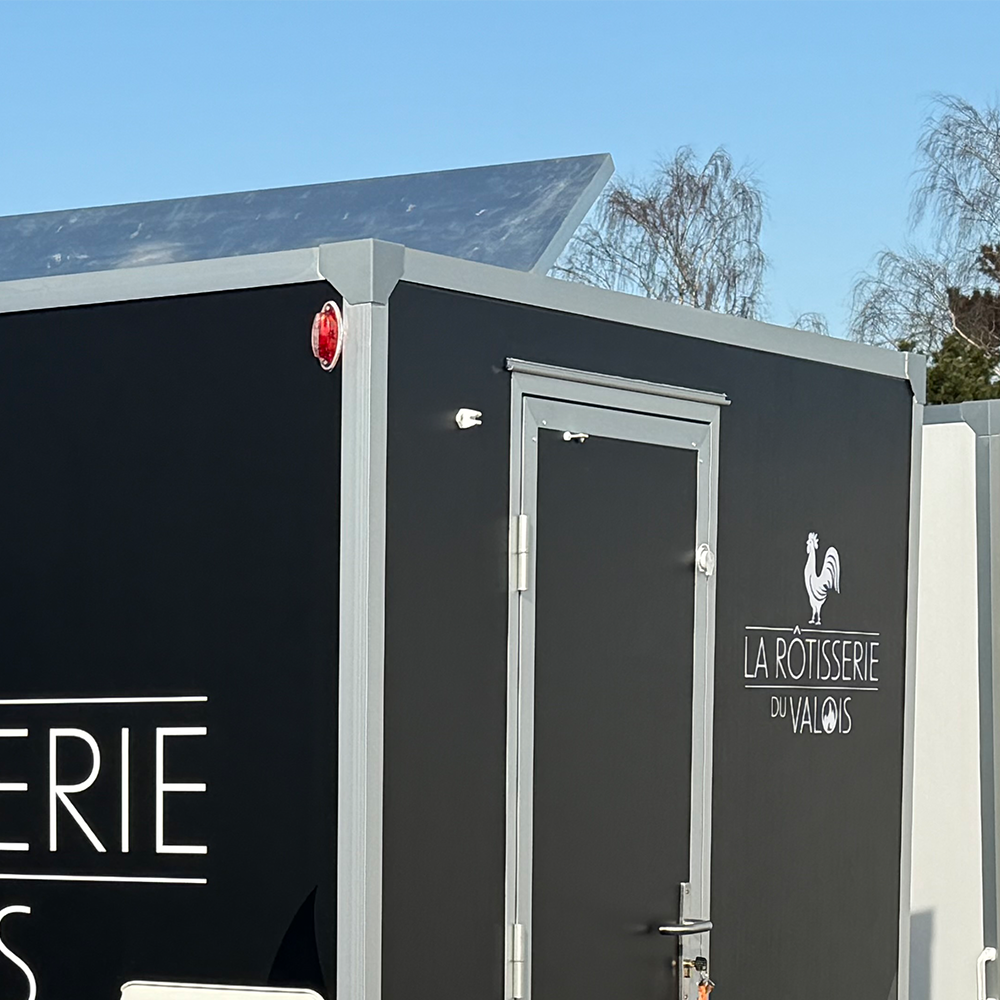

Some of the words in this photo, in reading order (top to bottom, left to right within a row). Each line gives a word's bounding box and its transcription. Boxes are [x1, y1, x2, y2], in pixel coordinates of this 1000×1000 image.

[744, 636, 769, 679] LA
[775, 625, 880, 682] RÔTISSERIE
[770, 696, 787, 718] DU
[789, 696, 852, 734] VALOIS
